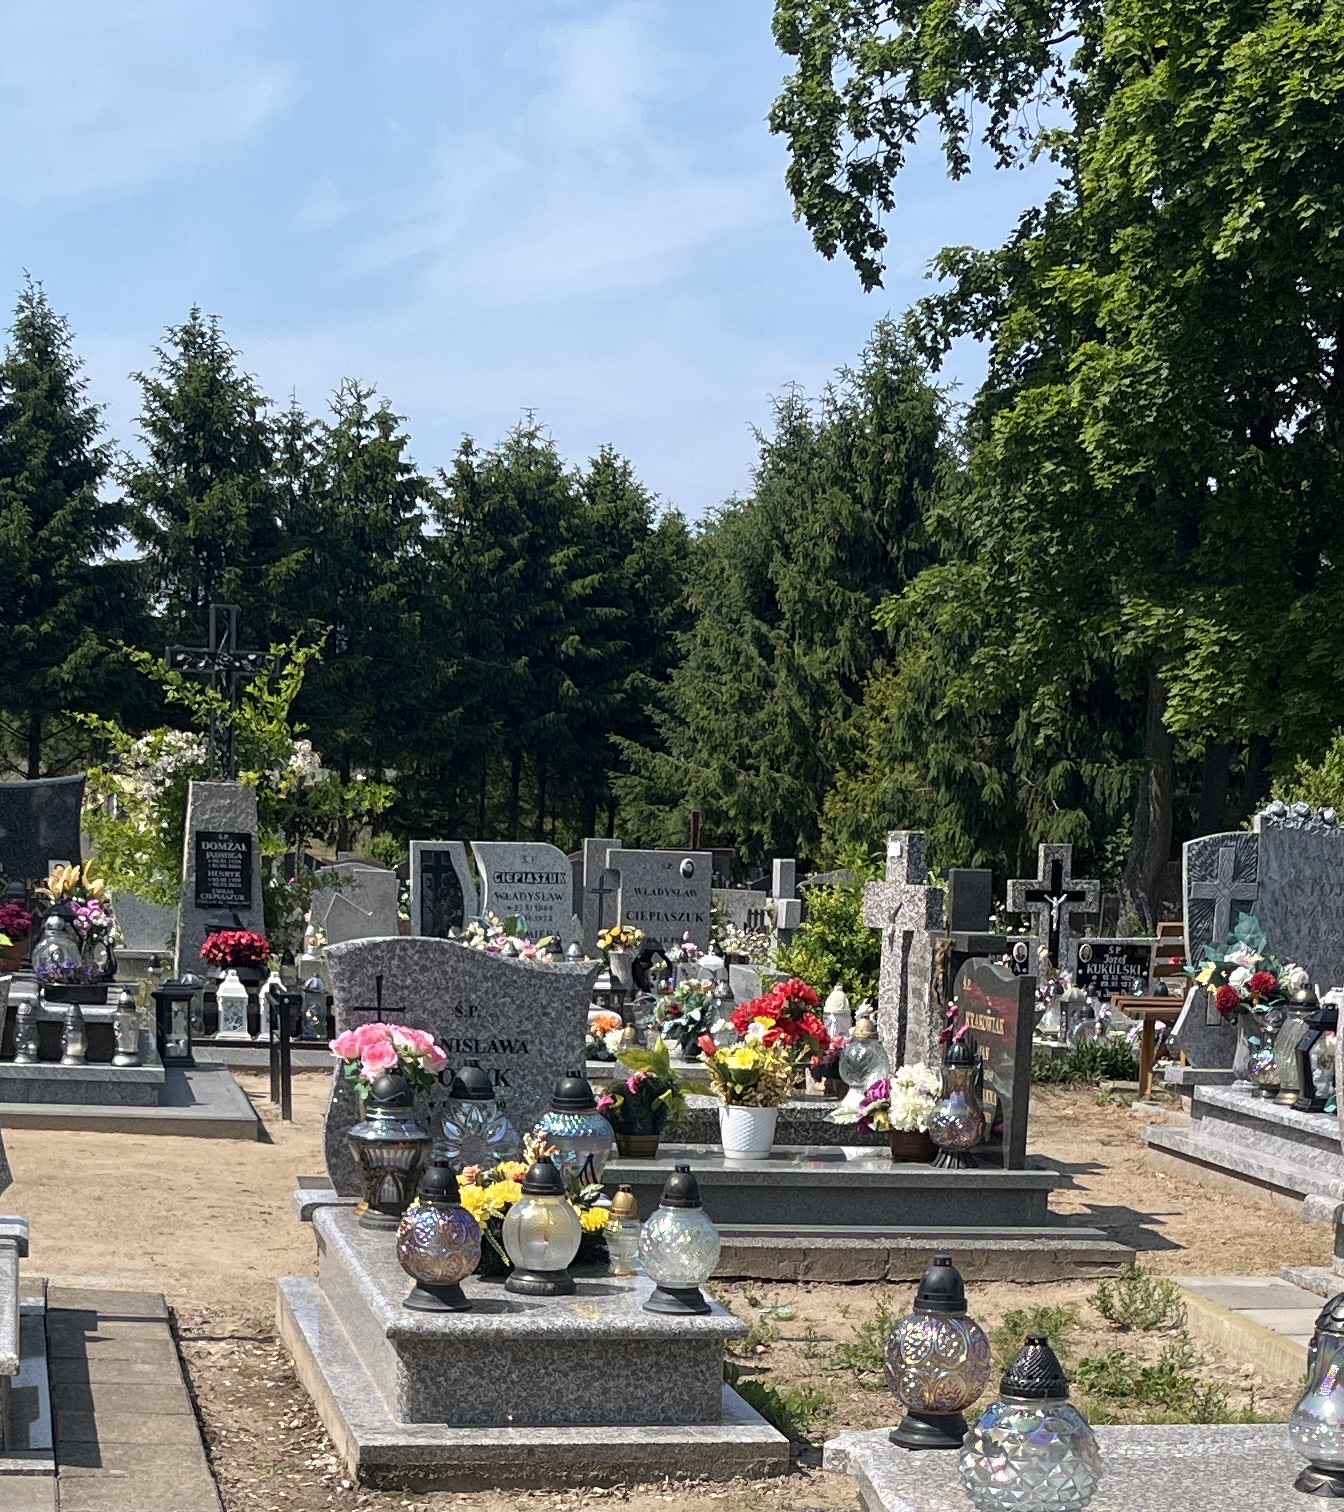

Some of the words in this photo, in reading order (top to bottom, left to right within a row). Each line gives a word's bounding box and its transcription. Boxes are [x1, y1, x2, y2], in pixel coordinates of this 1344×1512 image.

[493, 872, 567, 885] CIEPIASZUK
[626, 911, 704, 923] CIEPIASZUK
[1086, 963, 1141, 976] KUKULSKI
